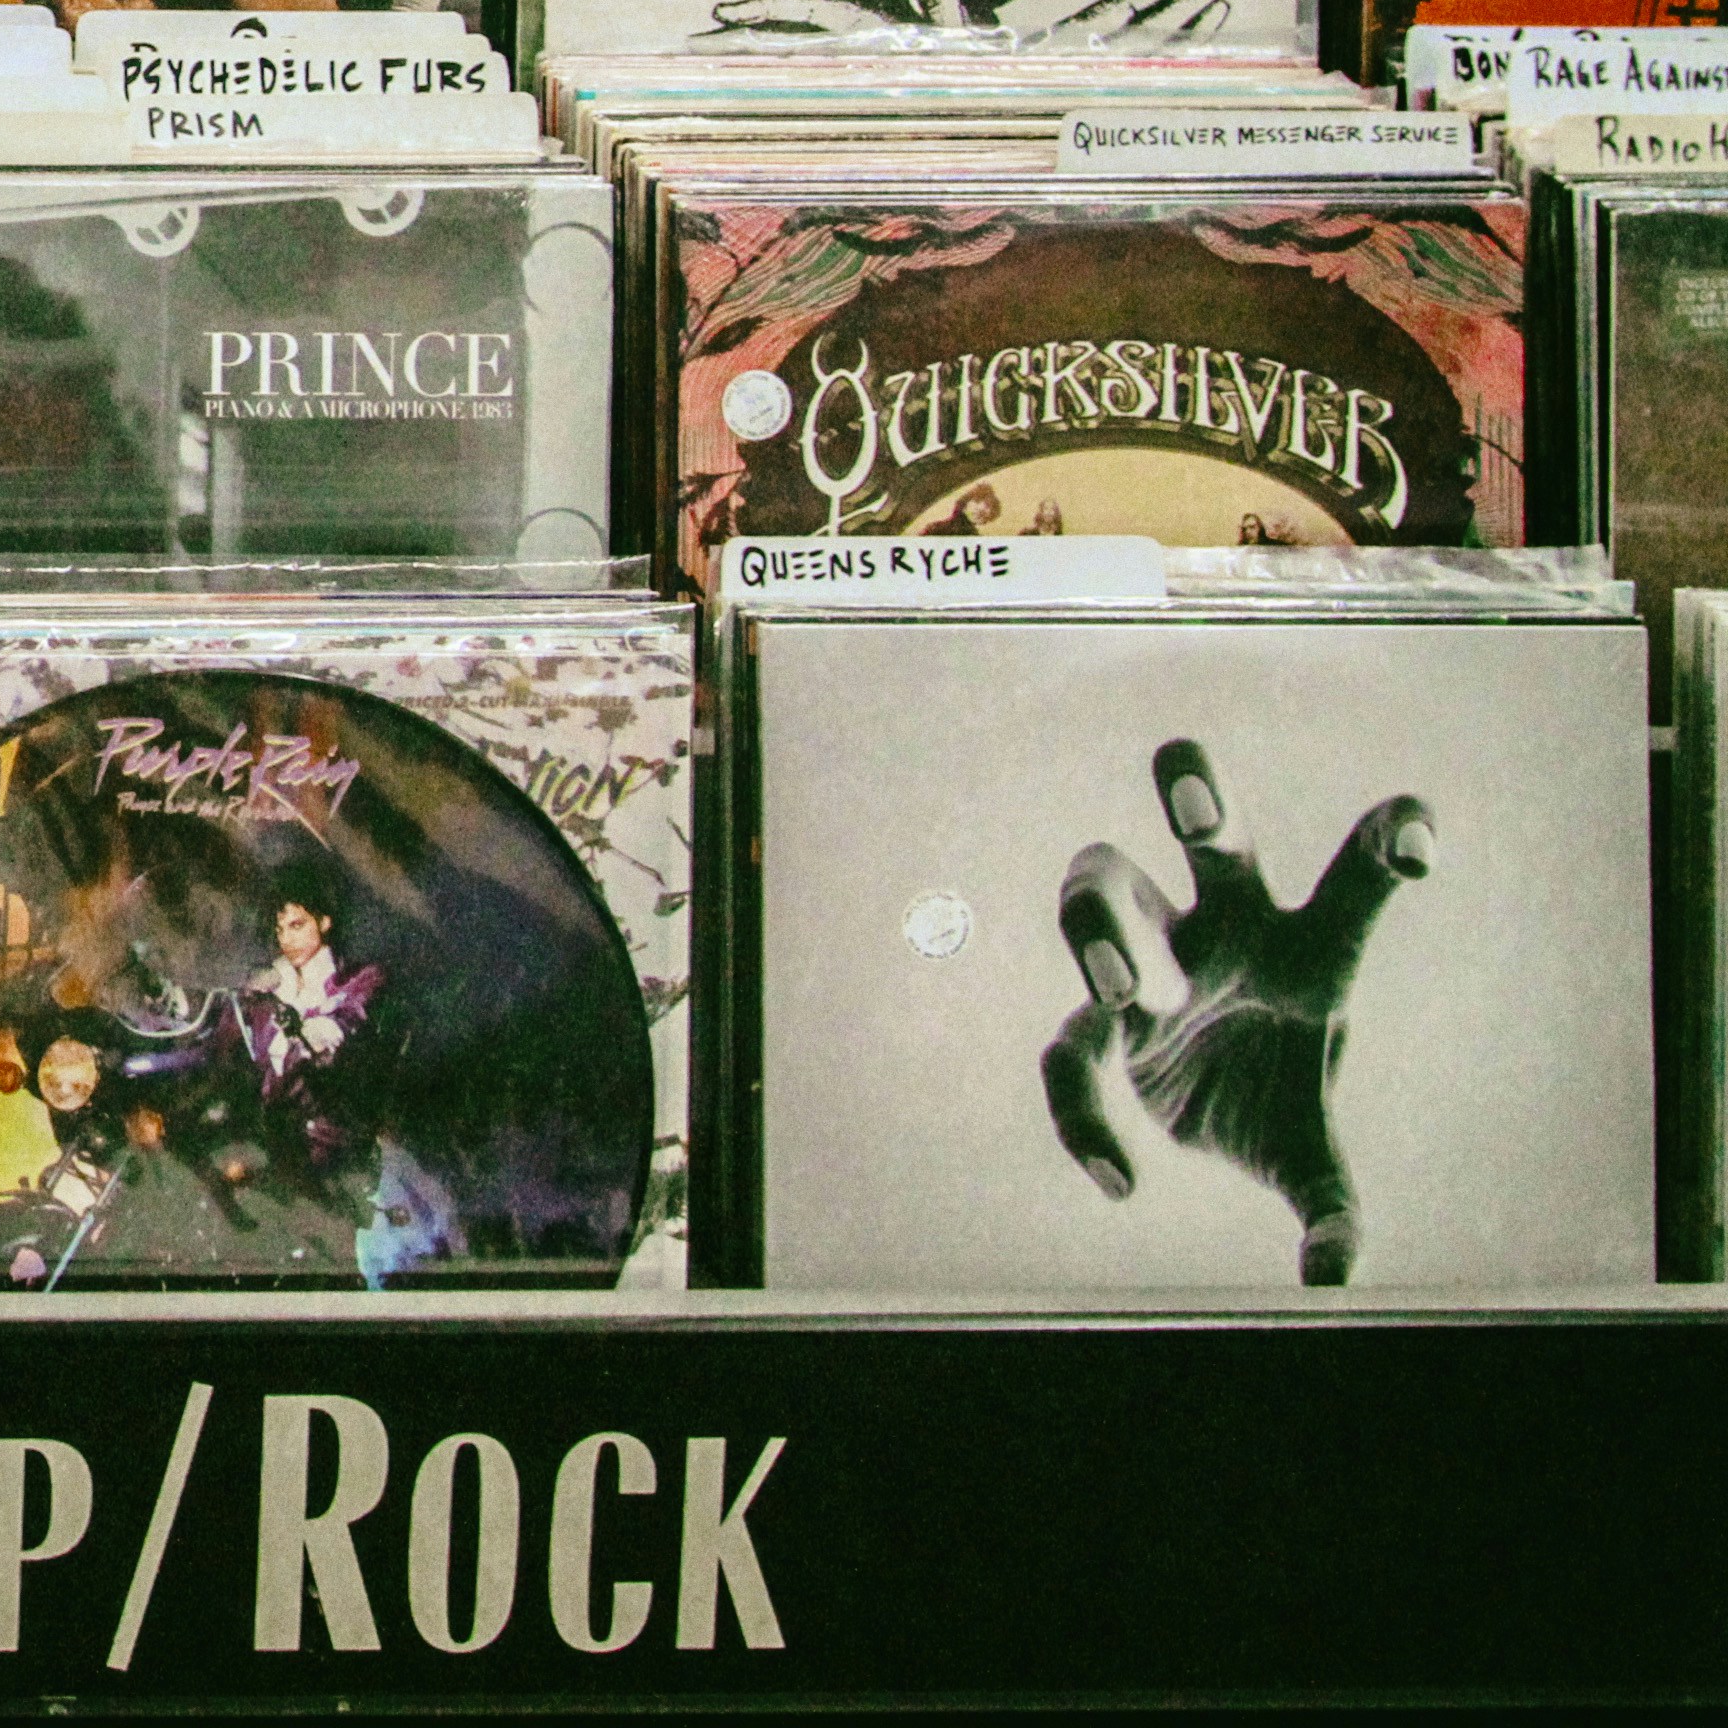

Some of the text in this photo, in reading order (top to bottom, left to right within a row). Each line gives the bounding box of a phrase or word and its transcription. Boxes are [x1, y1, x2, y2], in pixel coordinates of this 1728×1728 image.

[123, 57, 487, 102] PSYCHEDELIC FURS
[1526, 46, 1728, 92] RAGE AGAINS
[148, 107, 264, 139] PRISM
[1074, 121, 1458, 155] QUICKSILVER MESSENGER SERVICE
[202, 331, 514, 398] PRINCE
[206, 399, 513, 419] PIANO & A MICROPHONE 1983
[800, 331, 1409, 538] QUICKSILVER
[740, 544, 1012, 588] QUEENS RYCHE
[94, 717, 361, 848] Purple Rain
